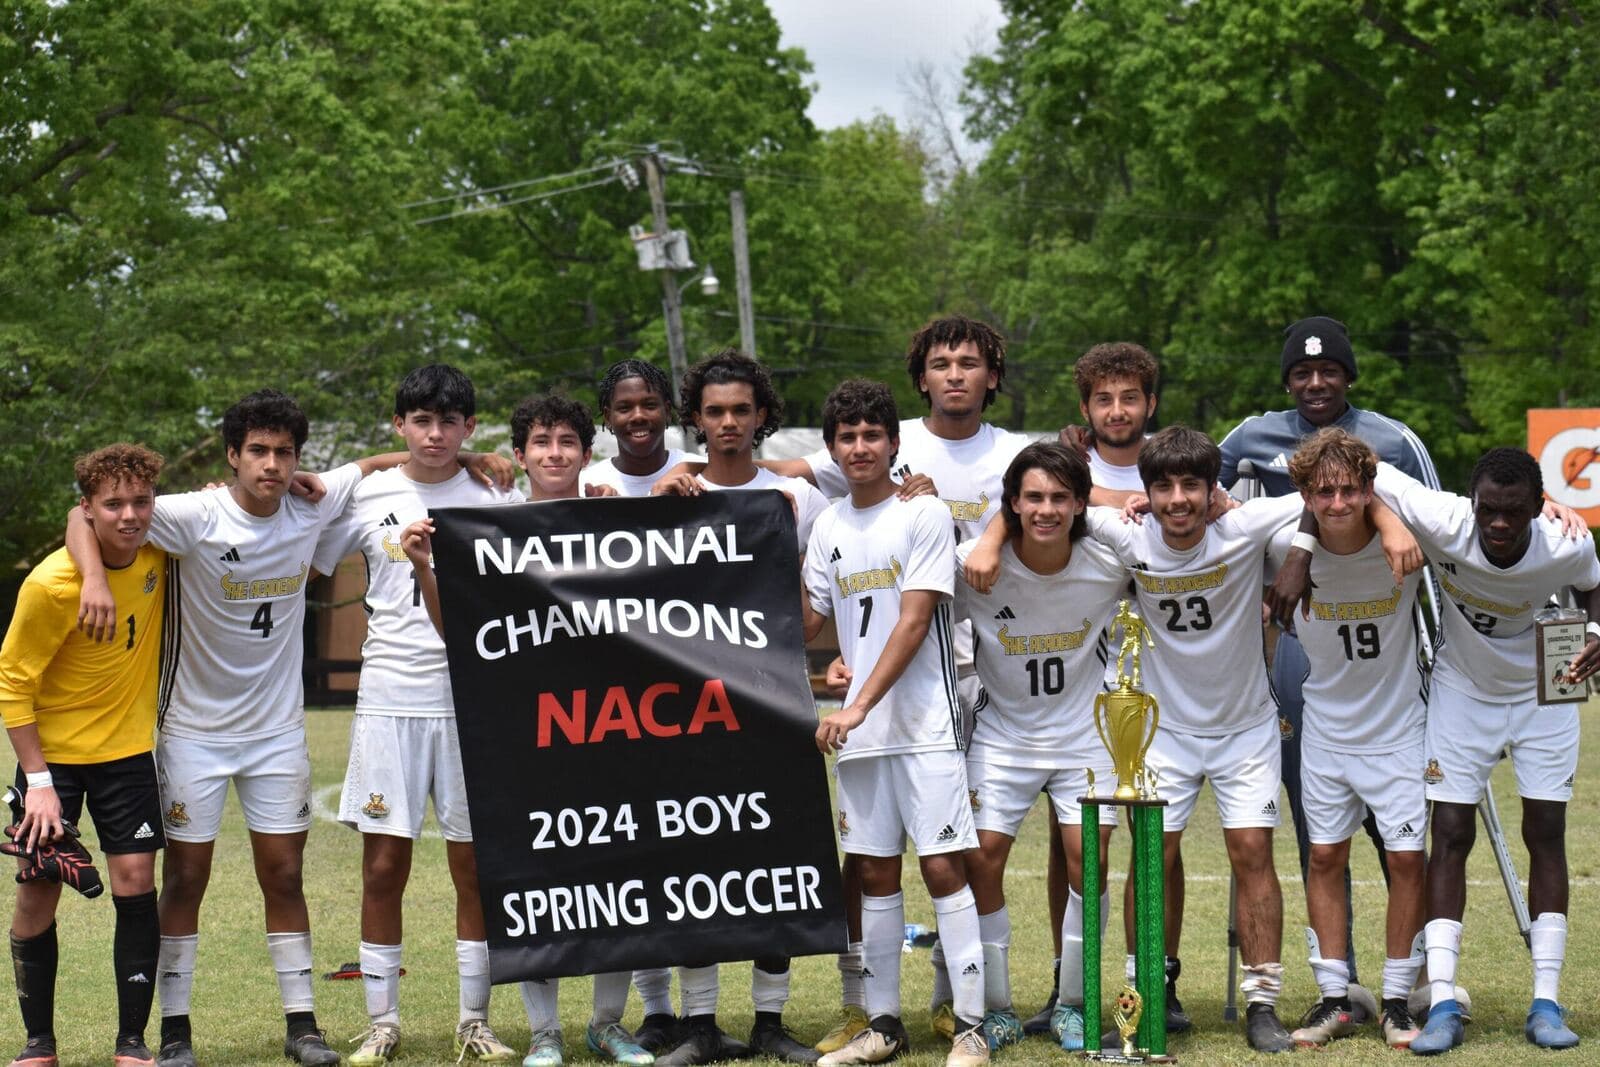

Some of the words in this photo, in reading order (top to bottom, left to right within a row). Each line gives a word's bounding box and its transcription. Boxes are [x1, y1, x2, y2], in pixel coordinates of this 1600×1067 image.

[474, 523, 753, 575] NATIONAL
[127, 614, 136, 650] 1
[250, 602, 274, 638] 4
[475, 598, 768, 661] CHAMPIONS
[859, 596, 873, 637] 7
[1159, 596, 1213, 632] 23
[1338, 623, 1380, 661] 19
[1025, 657, 1064, 697] 10
[536, 679, 741, 748] NACA
[529, 803, 638, 849] 2024
[656, 791, 771, 838] BOYS
[502, 879, 649, 937] SPRING
[665, 865, 823, 922] SOCCER
